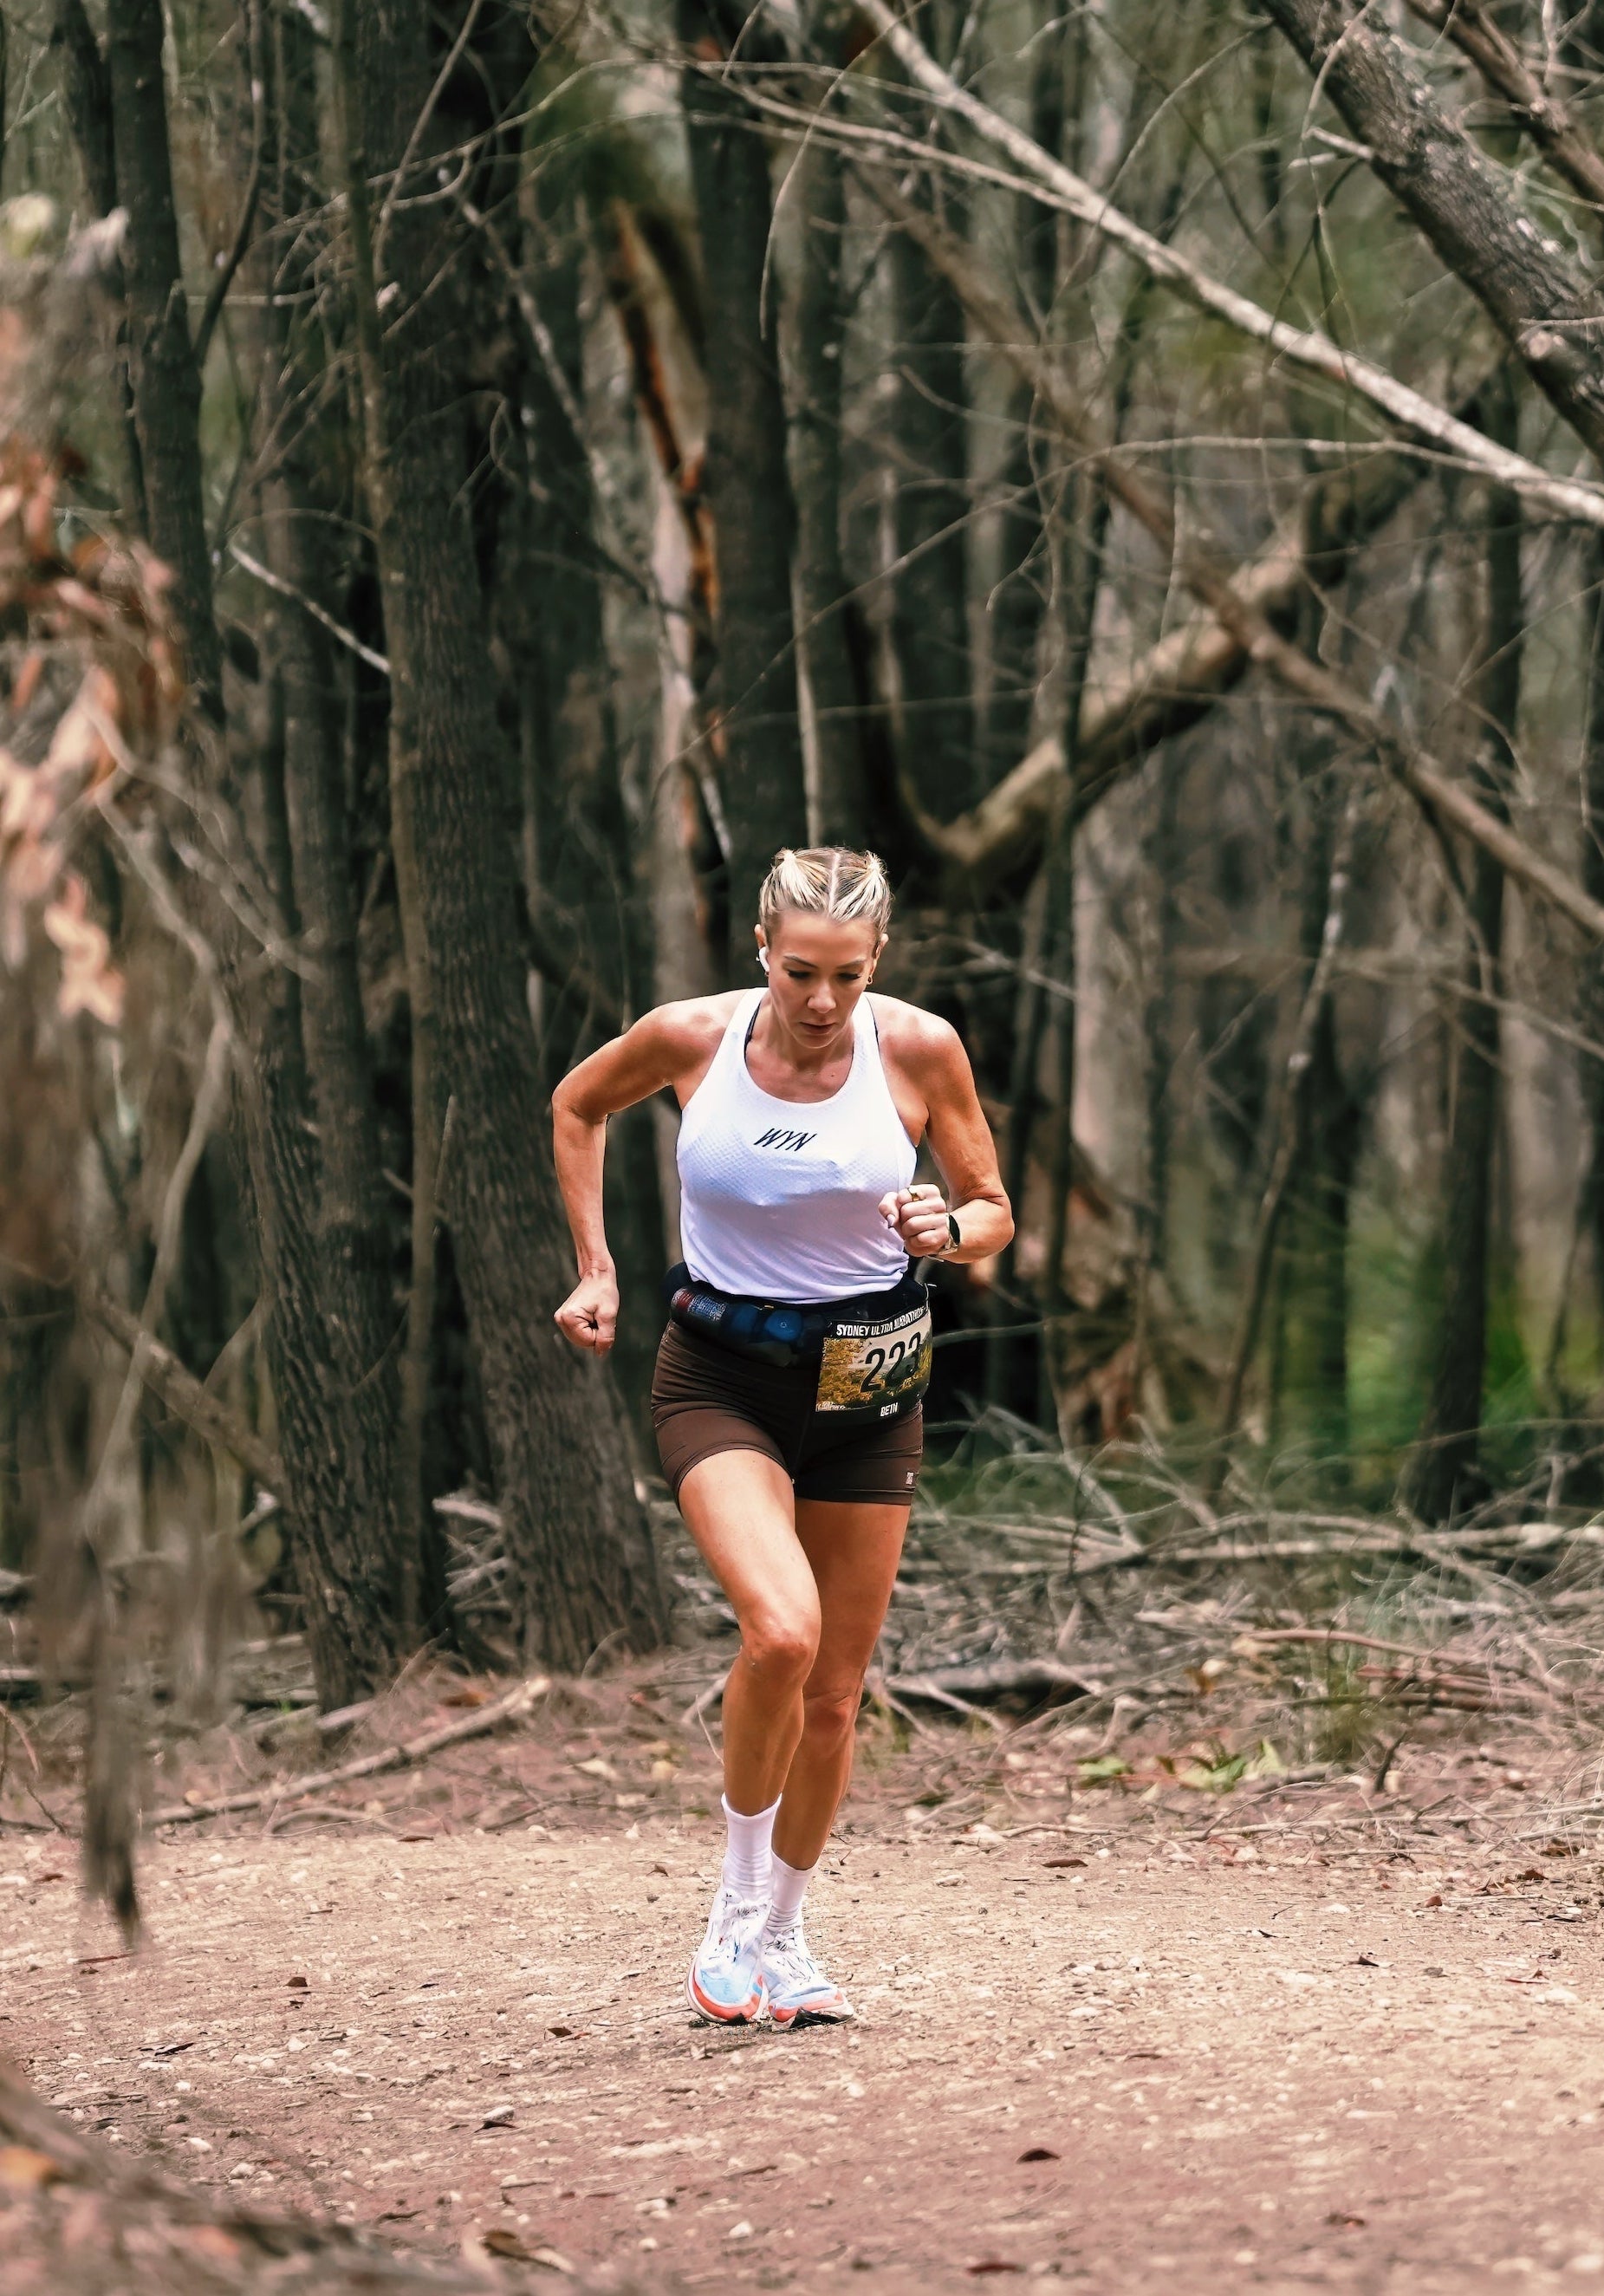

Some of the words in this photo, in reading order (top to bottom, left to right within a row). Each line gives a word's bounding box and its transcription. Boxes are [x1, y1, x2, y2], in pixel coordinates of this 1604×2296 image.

[753, 1128, 817, 1152] WYN
[835, 1324, 870, 1337] SYDNEY
[871, 1322, 893, 1336] ULTRA
